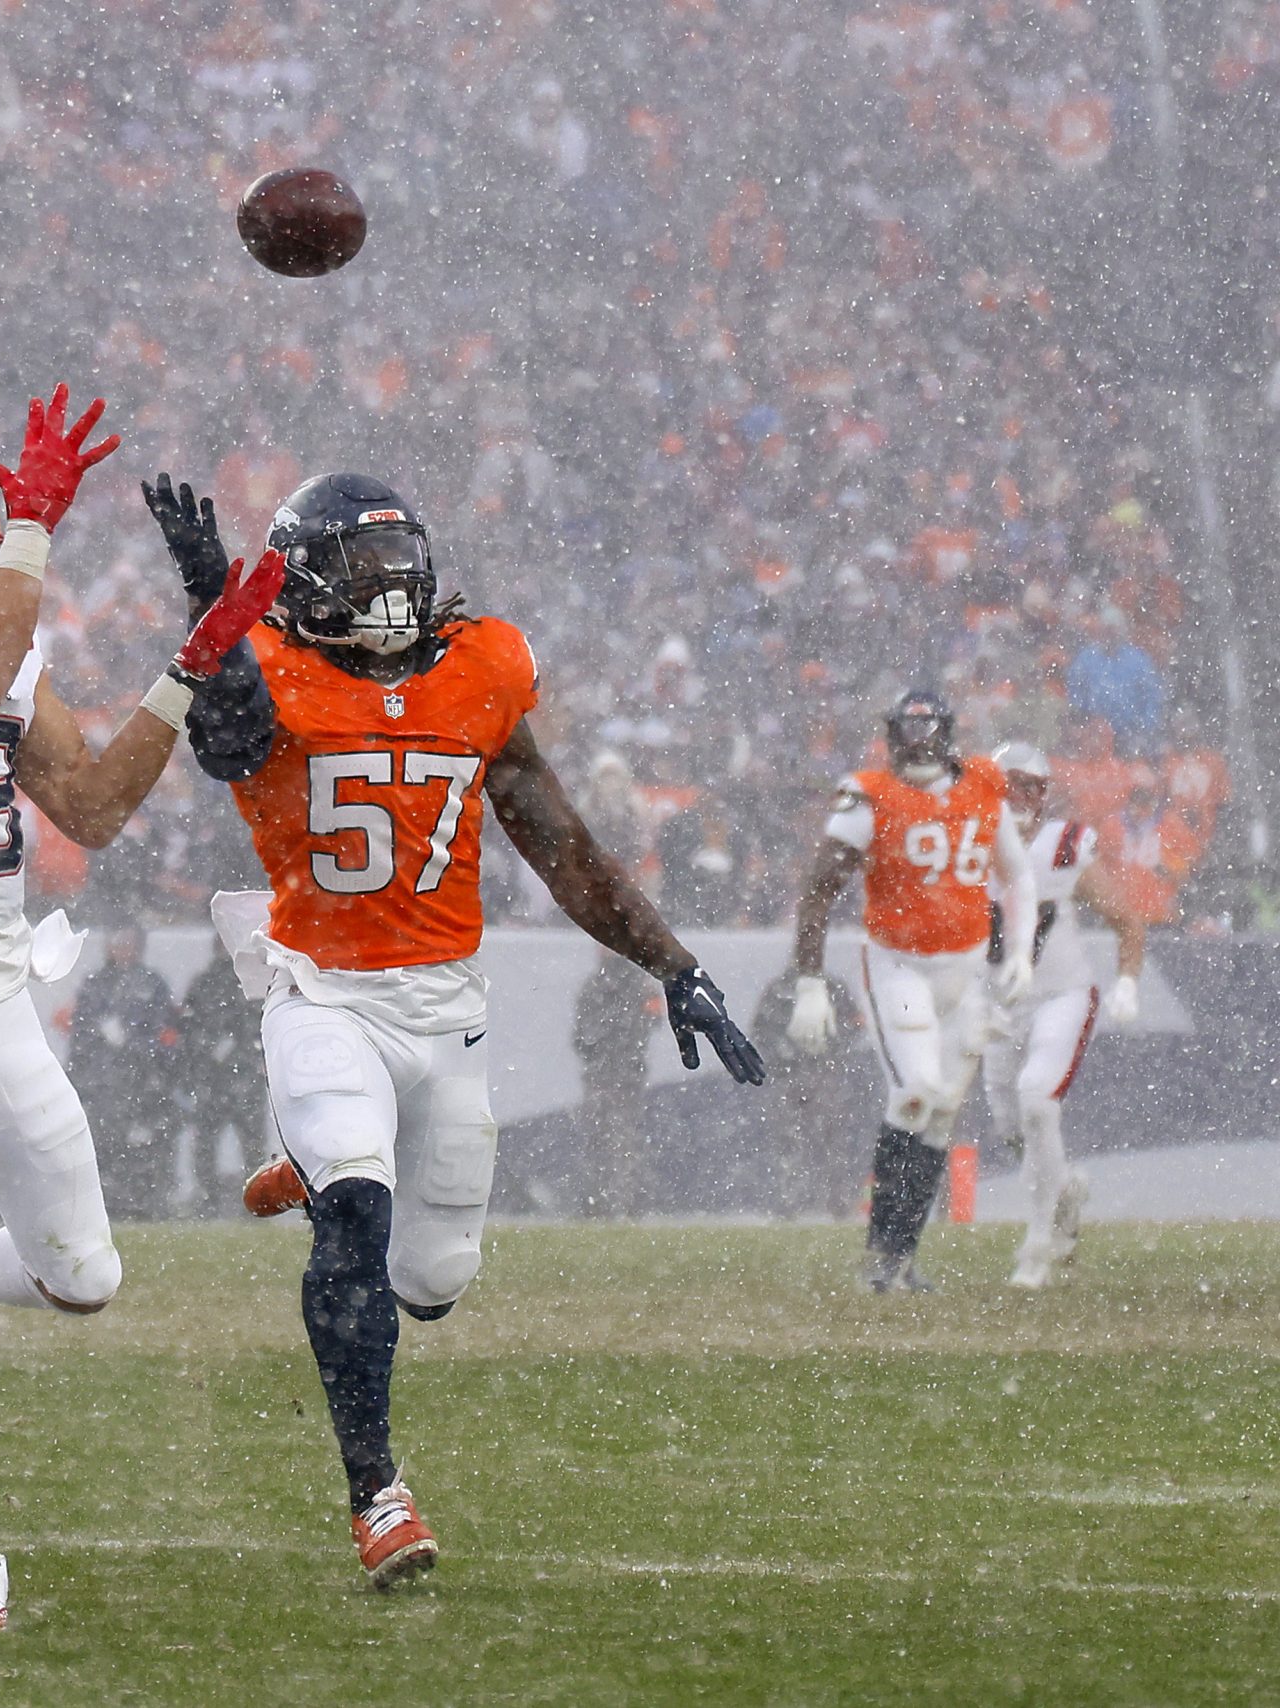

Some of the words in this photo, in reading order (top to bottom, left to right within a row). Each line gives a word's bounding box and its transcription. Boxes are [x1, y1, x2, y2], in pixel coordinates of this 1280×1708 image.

[367, 511, 400, 524] 5280
[387, 704, 402, 715] NFL
[306, 750, 483, 896] 57
[905, 817, 989, 887] 96
